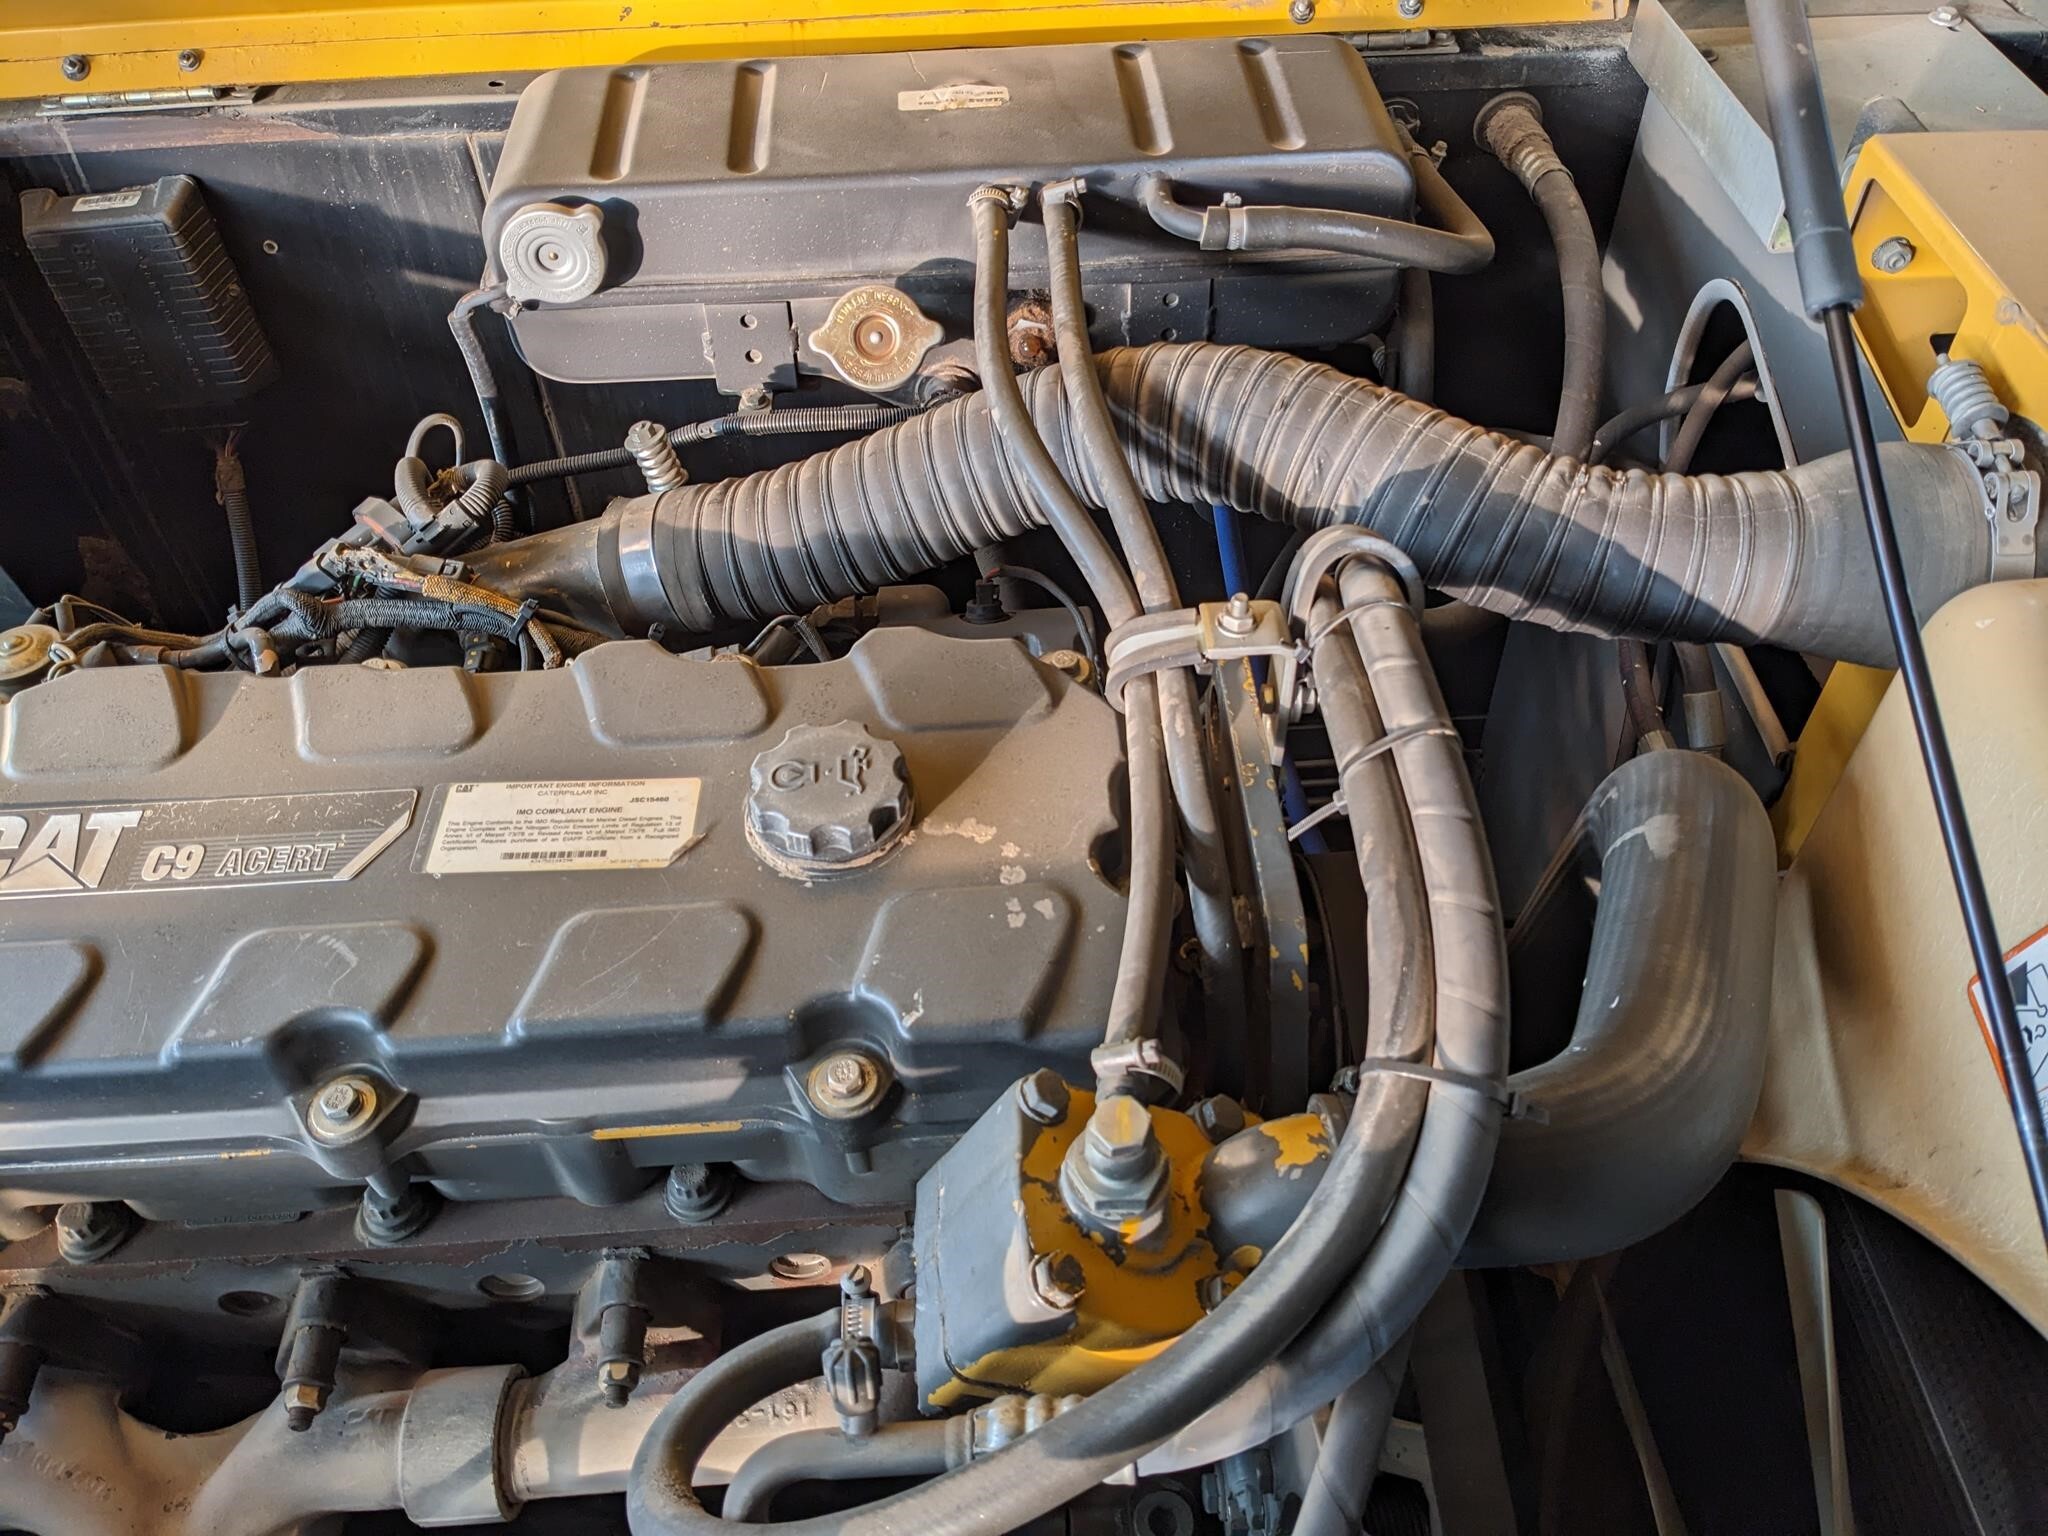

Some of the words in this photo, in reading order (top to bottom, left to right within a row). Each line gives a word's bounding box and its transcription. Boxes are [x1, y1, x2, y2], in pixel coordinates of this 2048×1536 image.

[455, 784, 475, 793] CAT
[534, 807, 587, 815] COMPLIANT
[588, 806, 624, 814] ENGINE
[142, 843, 206, 881] C9
[214, 843, 338, 877] ACERT
